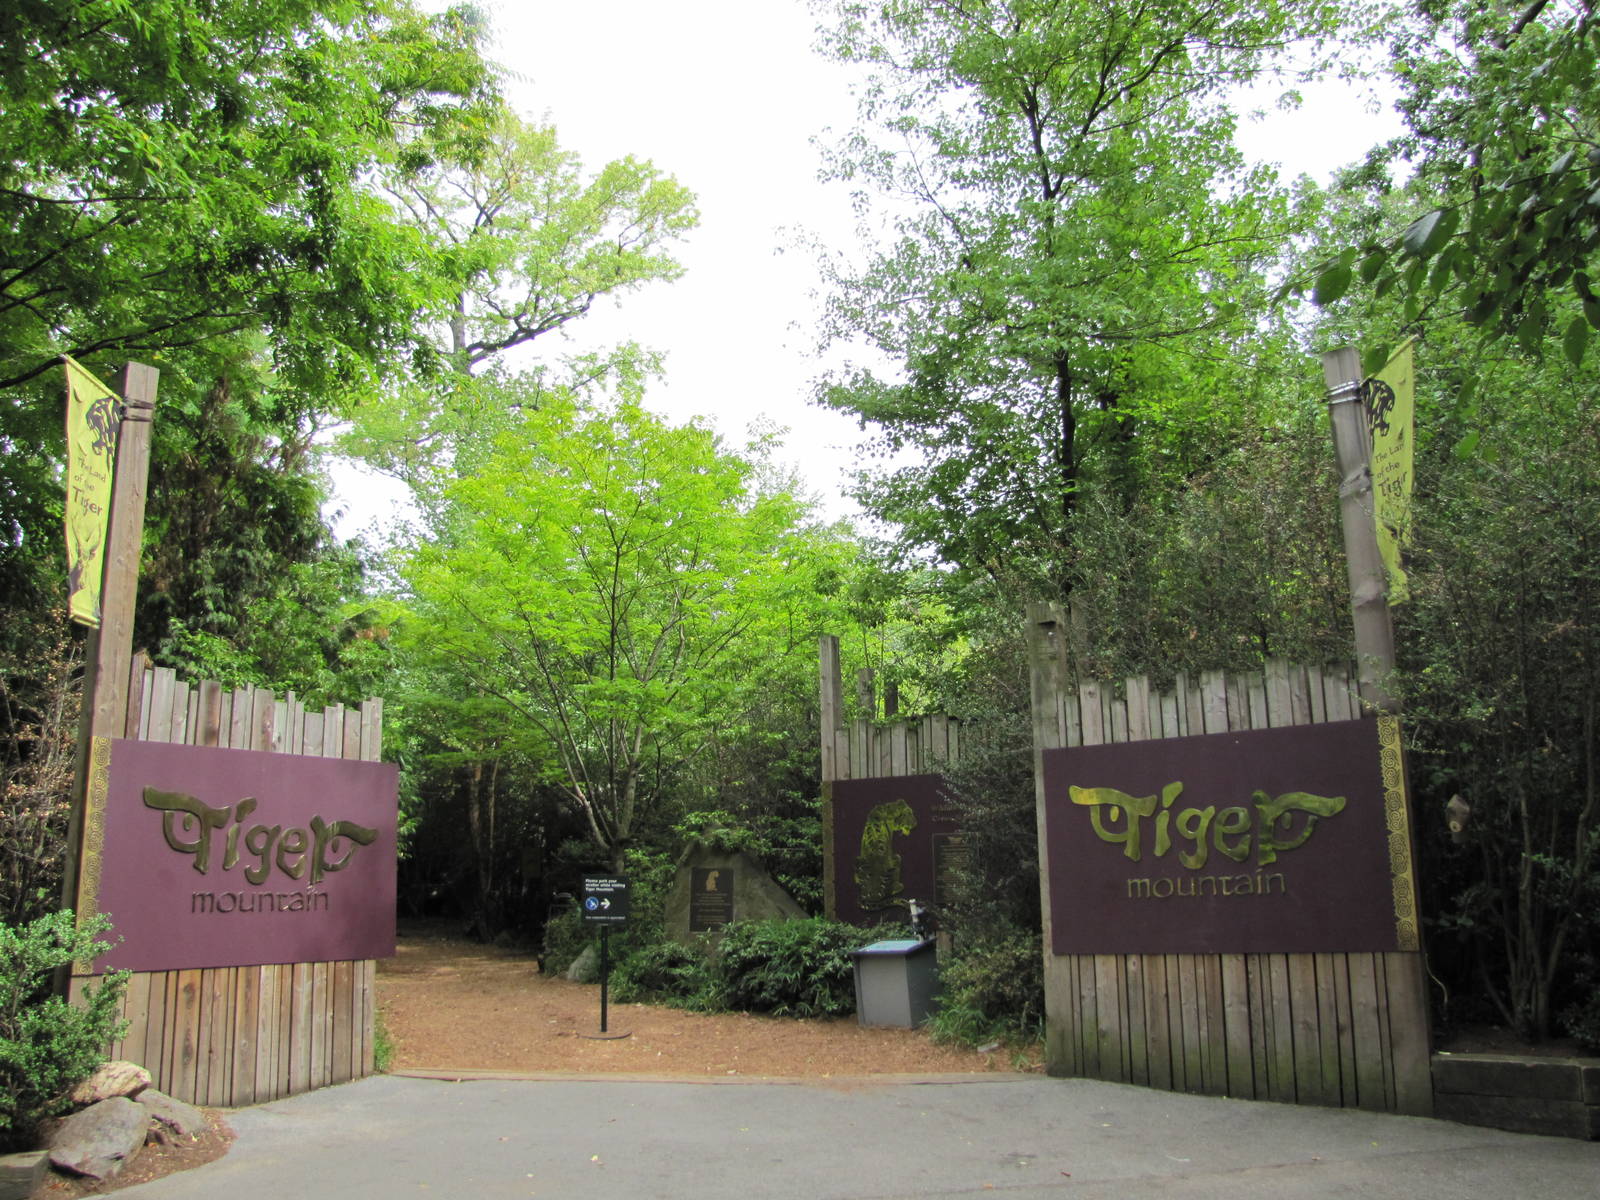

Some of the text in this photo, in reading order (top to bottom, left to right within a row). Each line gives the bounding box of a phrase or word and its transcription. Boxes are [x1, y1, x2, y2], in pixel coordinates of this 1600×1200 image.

[73, 486, 103, 517] Tiger
[143, 784, 379, 885] Tiger
[1069, 781, 1347, 870] Tiger
[1127, 868, 1286, 898] mountain
[191, 884, 328, 914] mountain
